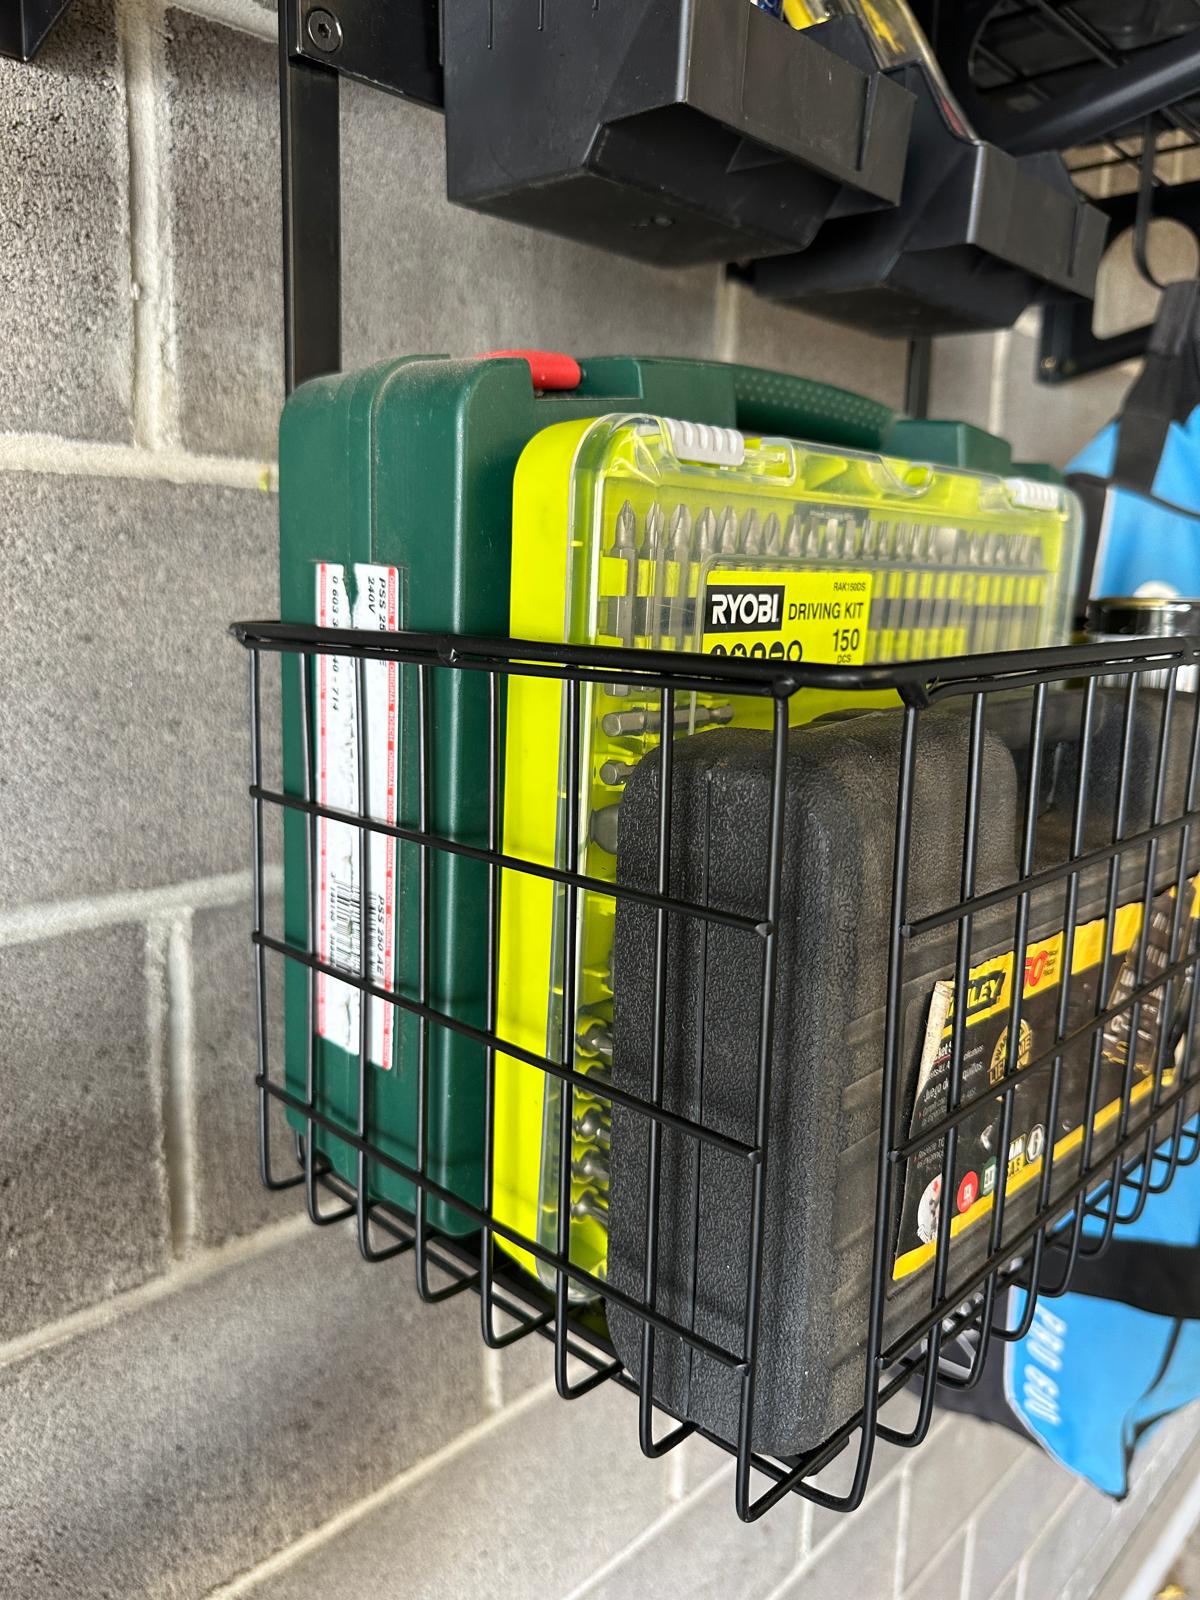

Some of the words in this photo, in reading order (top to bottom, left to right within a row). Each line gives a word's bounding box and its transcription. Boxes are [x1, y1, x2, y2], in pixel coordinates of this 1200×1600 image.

[367, 575, 376, 614] 240V
[378, 577, 387, 609] PSS
[833, 582, 867, 592] RAK150DS
[331, 588, 339, 613] 603
[711, 593, 778, 625] RYOBI
[788, 603, 841, 621] DRIVING
[843, 602, 865, 619] KIT
[832, 628, 860, 653] 150
[331, 687, 339, 711] 714
[377, 894, 385, 924] PSS
[377, 926, 385, 951] 250
[376, 954, 385, 977] AE
[1026, 1302, 1067, 1372] PRO
